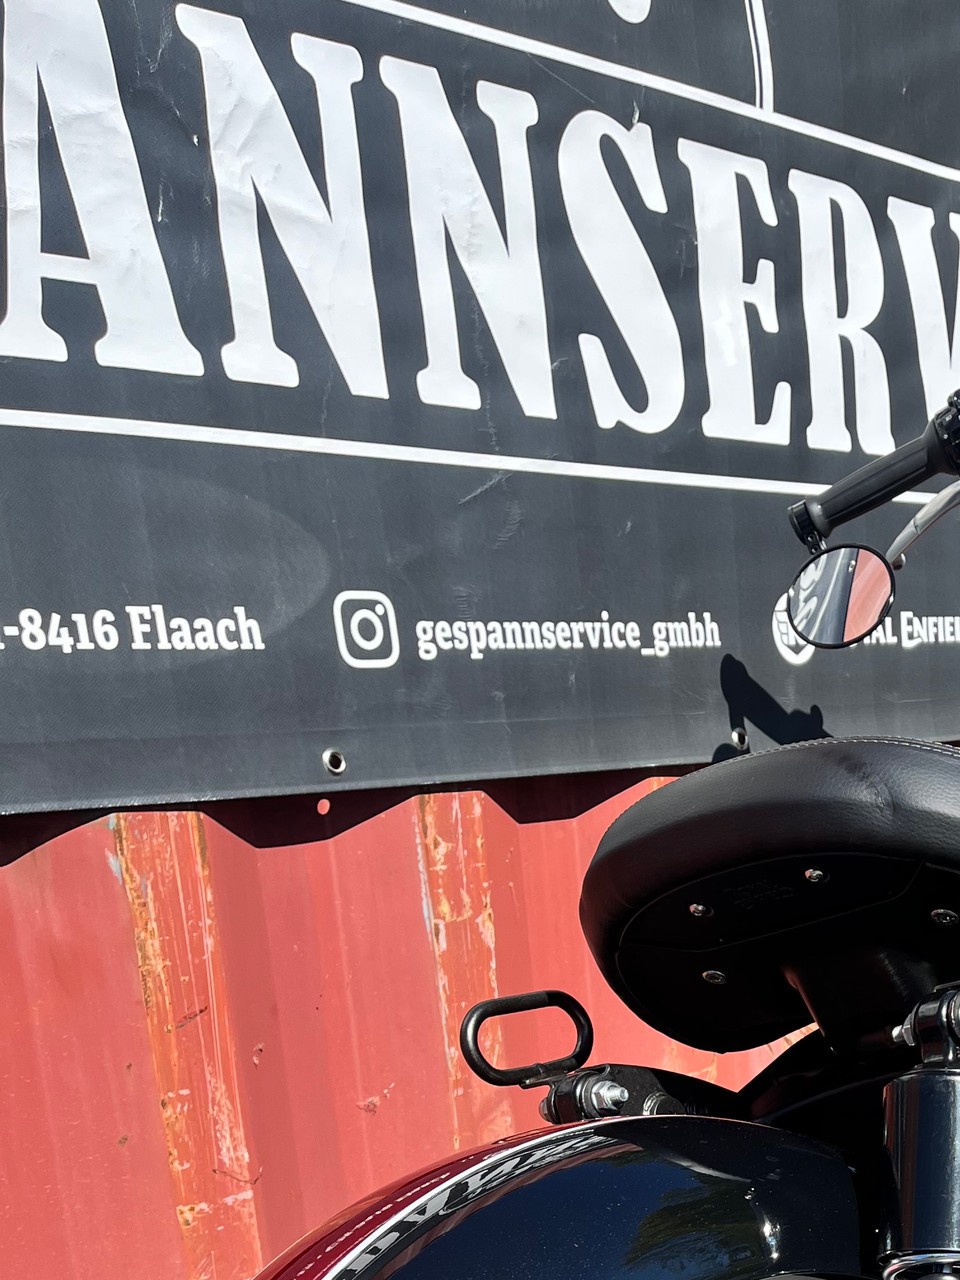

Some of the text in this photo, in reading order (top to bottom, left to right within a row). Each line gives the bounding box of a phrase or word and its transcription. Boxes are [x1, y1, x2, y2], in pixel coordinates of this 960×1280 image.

[0, 604, 266, 654] -8416 Flaach
[415, 610, 722, 660] gespannservice_gmbh
